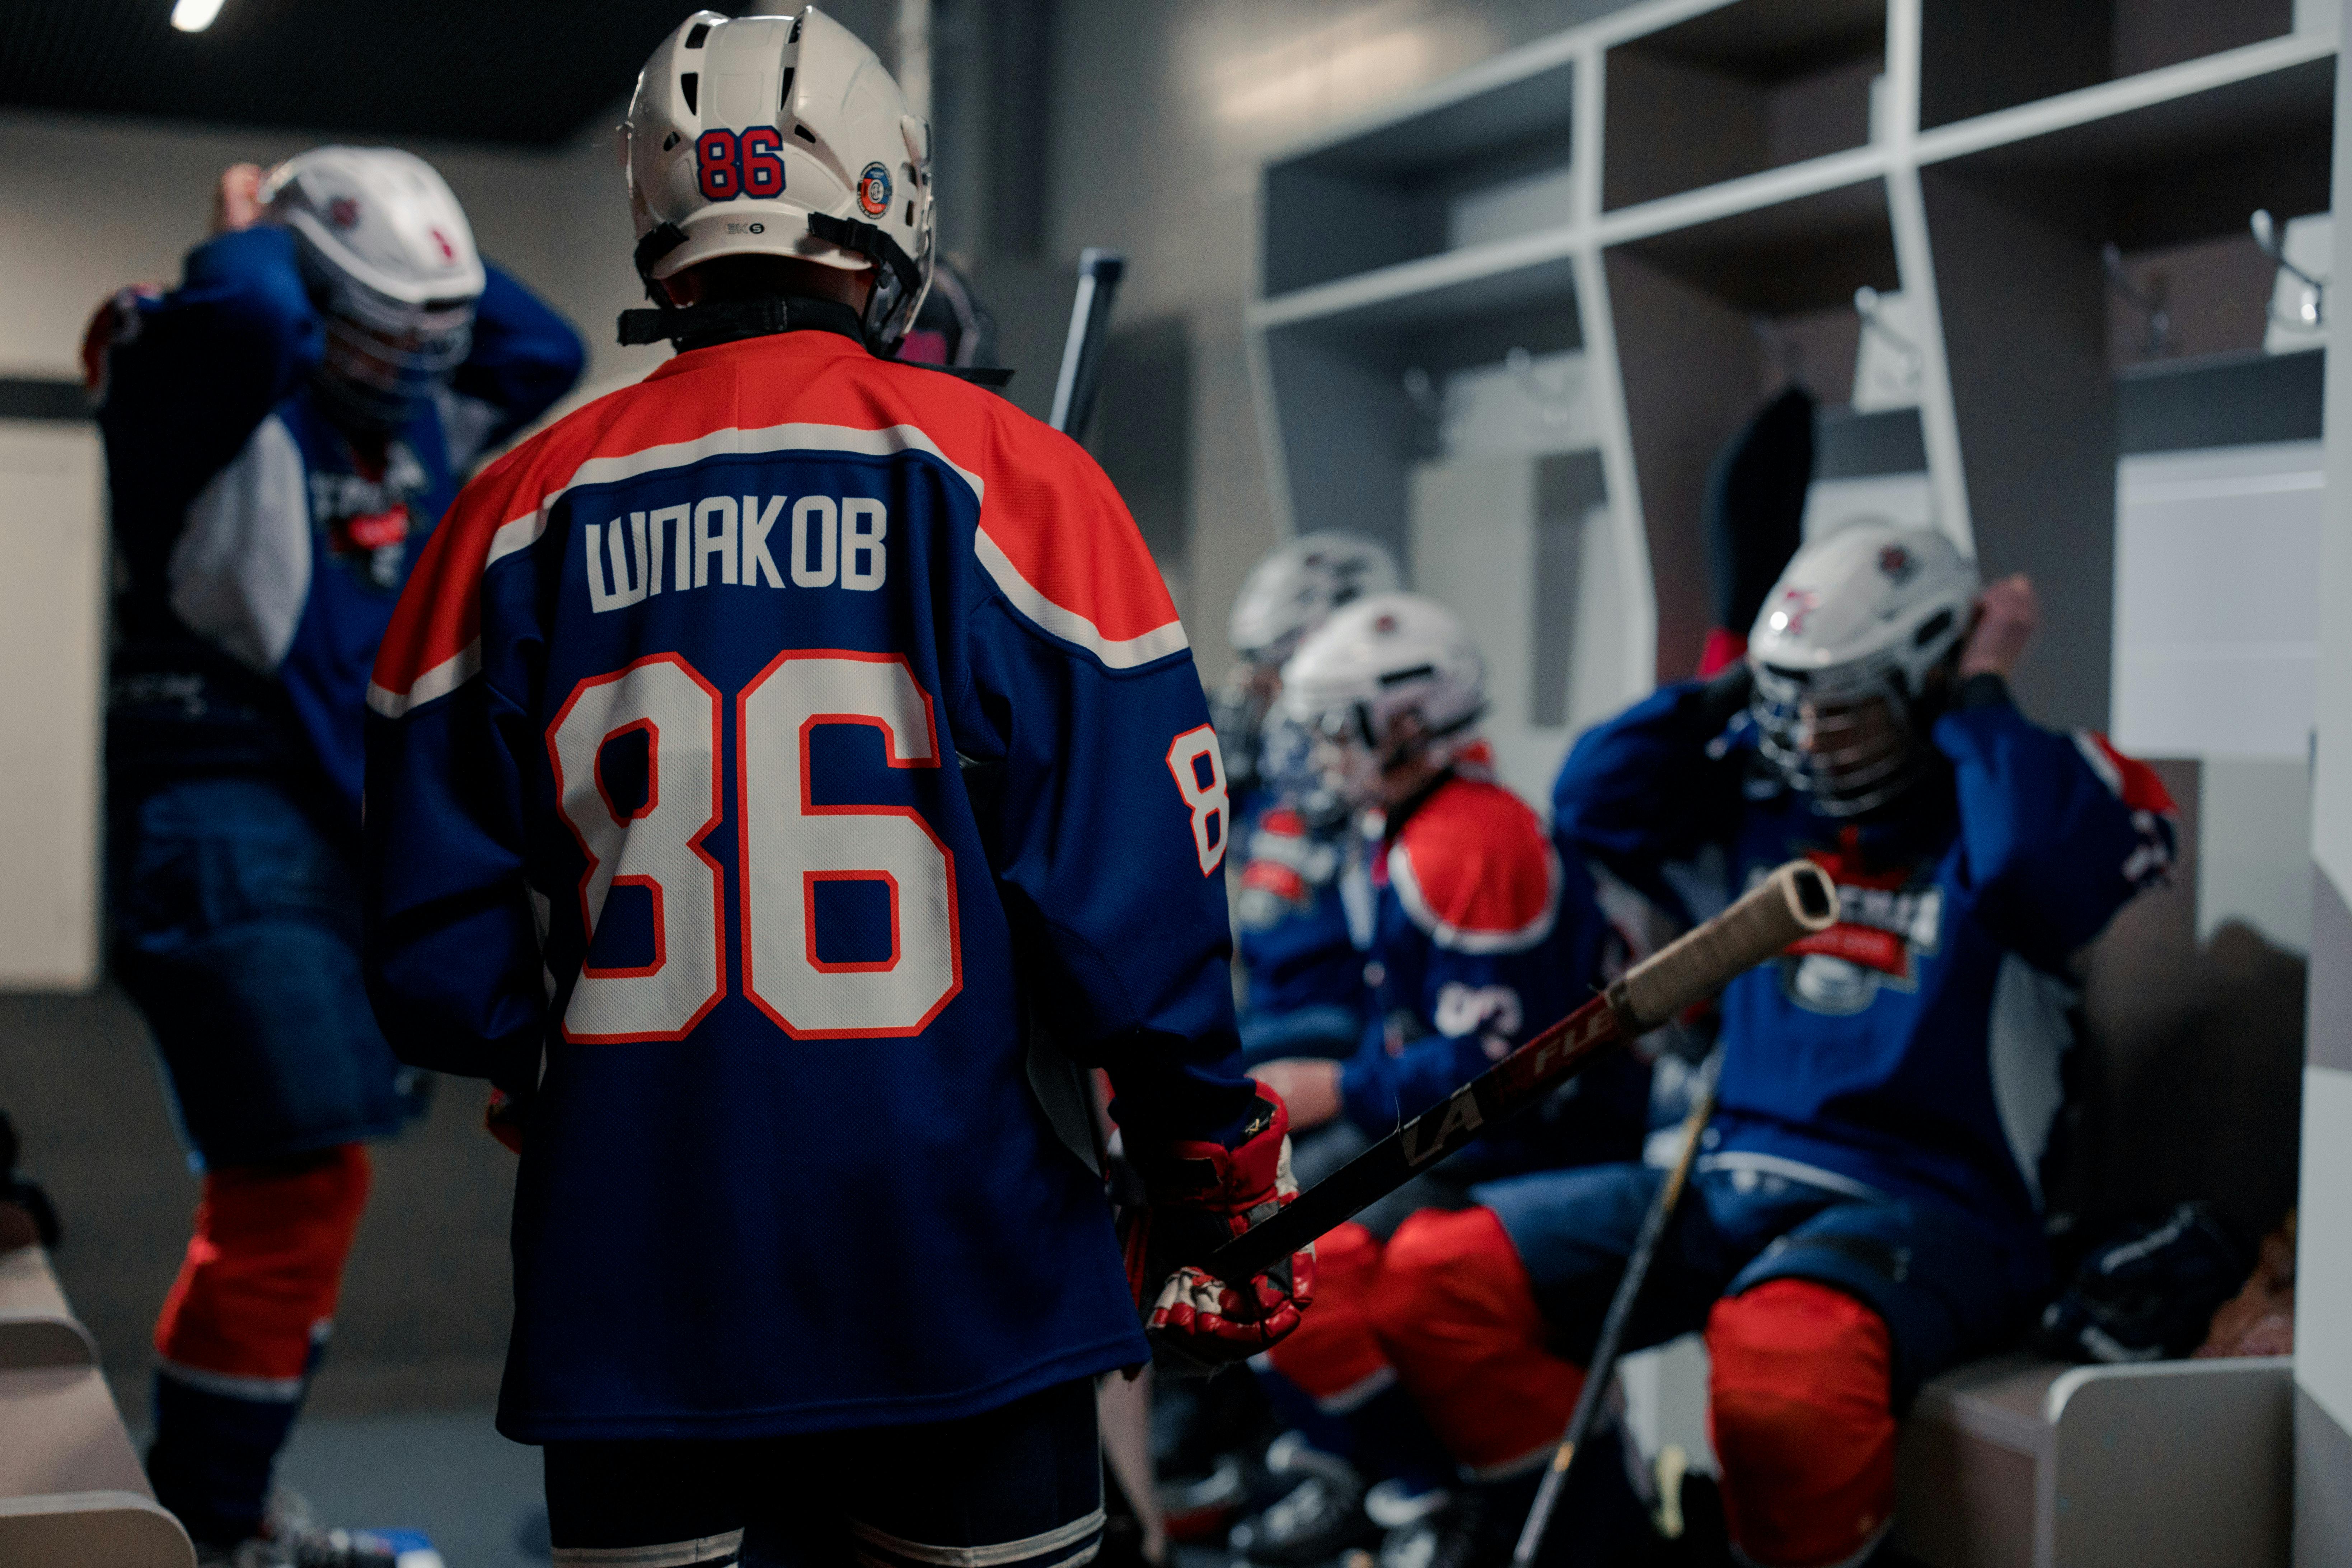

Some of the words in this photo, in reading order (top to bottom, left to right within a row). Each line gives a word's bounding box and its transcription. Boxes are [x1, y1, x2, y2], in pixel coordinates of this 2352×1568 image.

[695, 125, 786, 202] 86
[585, 495, 887, 613] ШПАКОВ
[545, 648, 963, 1044] 86
[1165, 722, 1229, 878] 8
